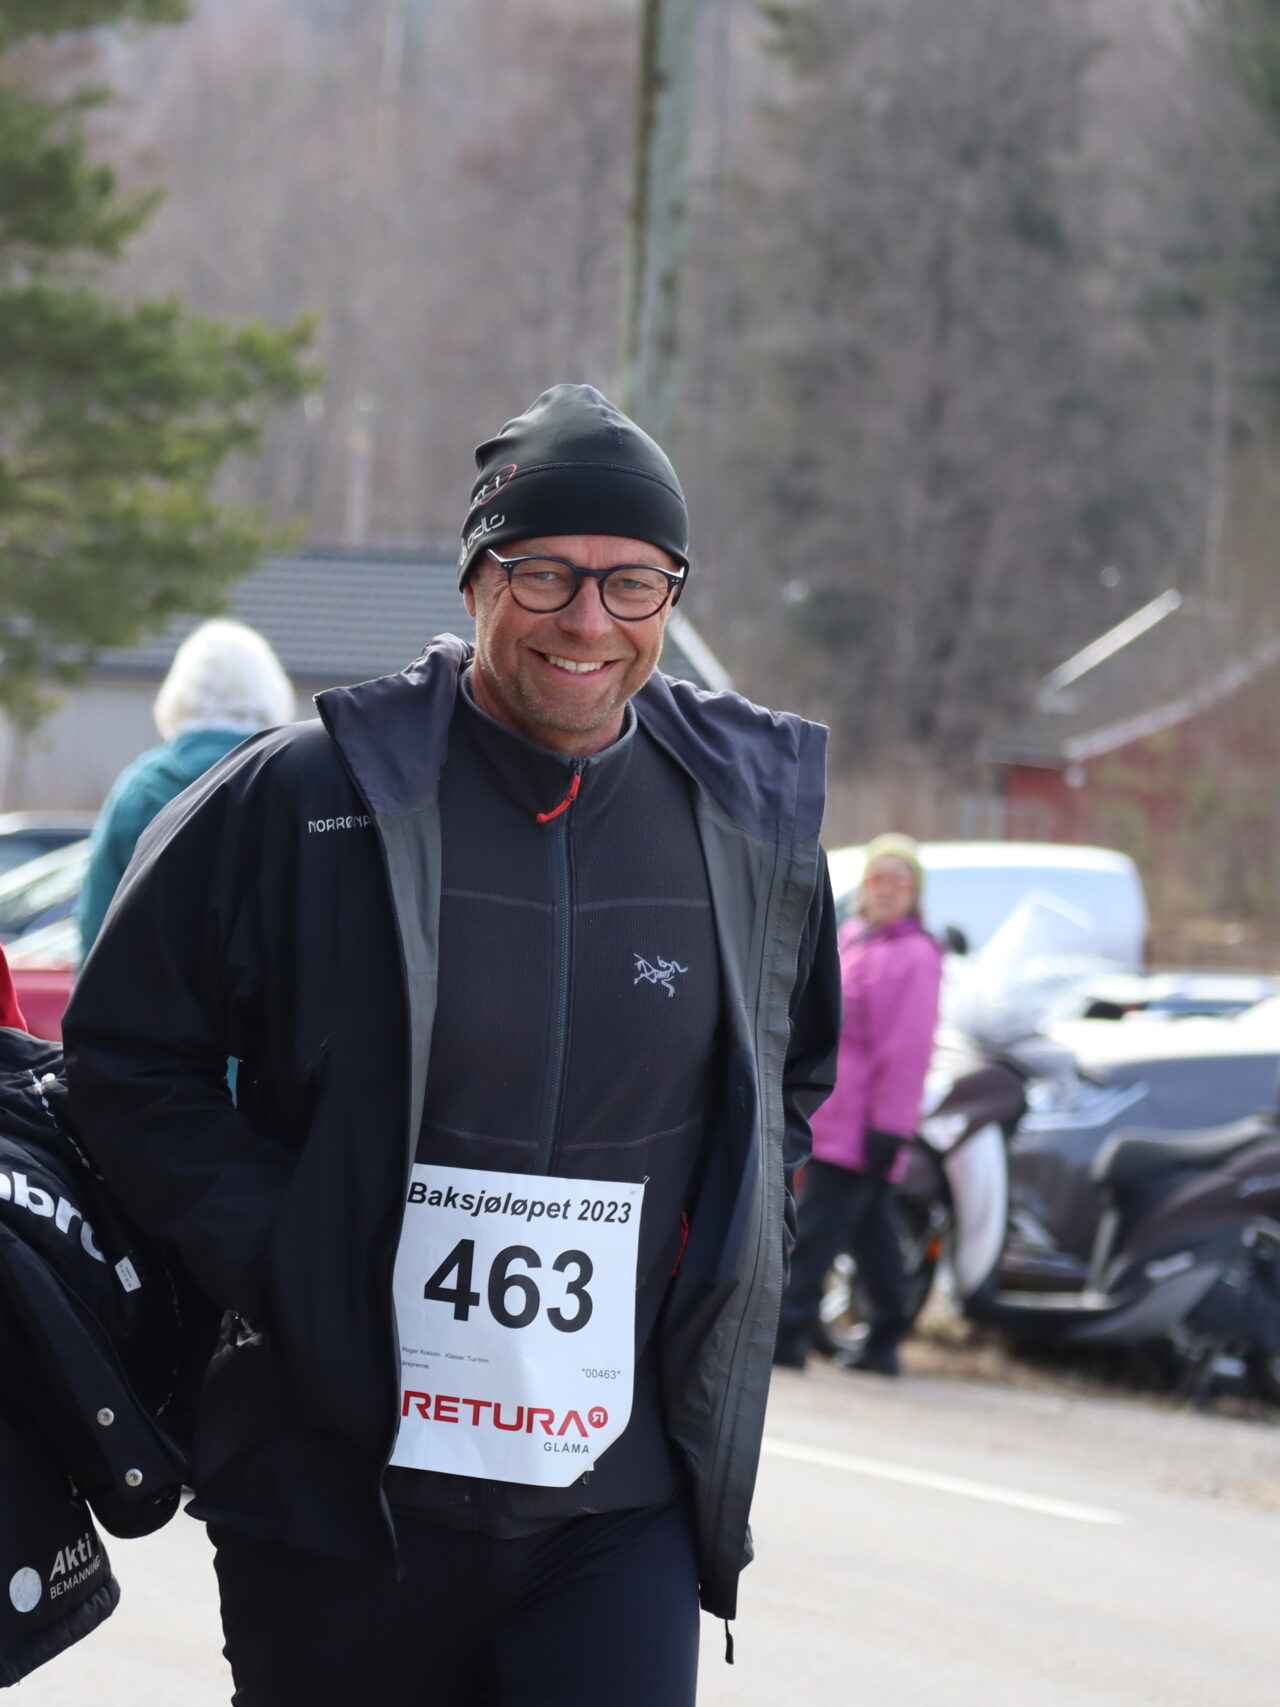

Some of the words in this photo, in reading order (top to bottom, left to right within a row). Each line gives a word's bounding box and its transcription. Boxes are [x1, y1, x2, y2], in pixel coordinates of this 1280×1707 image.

[407, 1181, 571, 1222] Baksjøløpet
[577, 1199, 631, 1224] 2023
[423, 1238, 594, 1334] 463
[401, 1389, 589, 1438] RETURA
